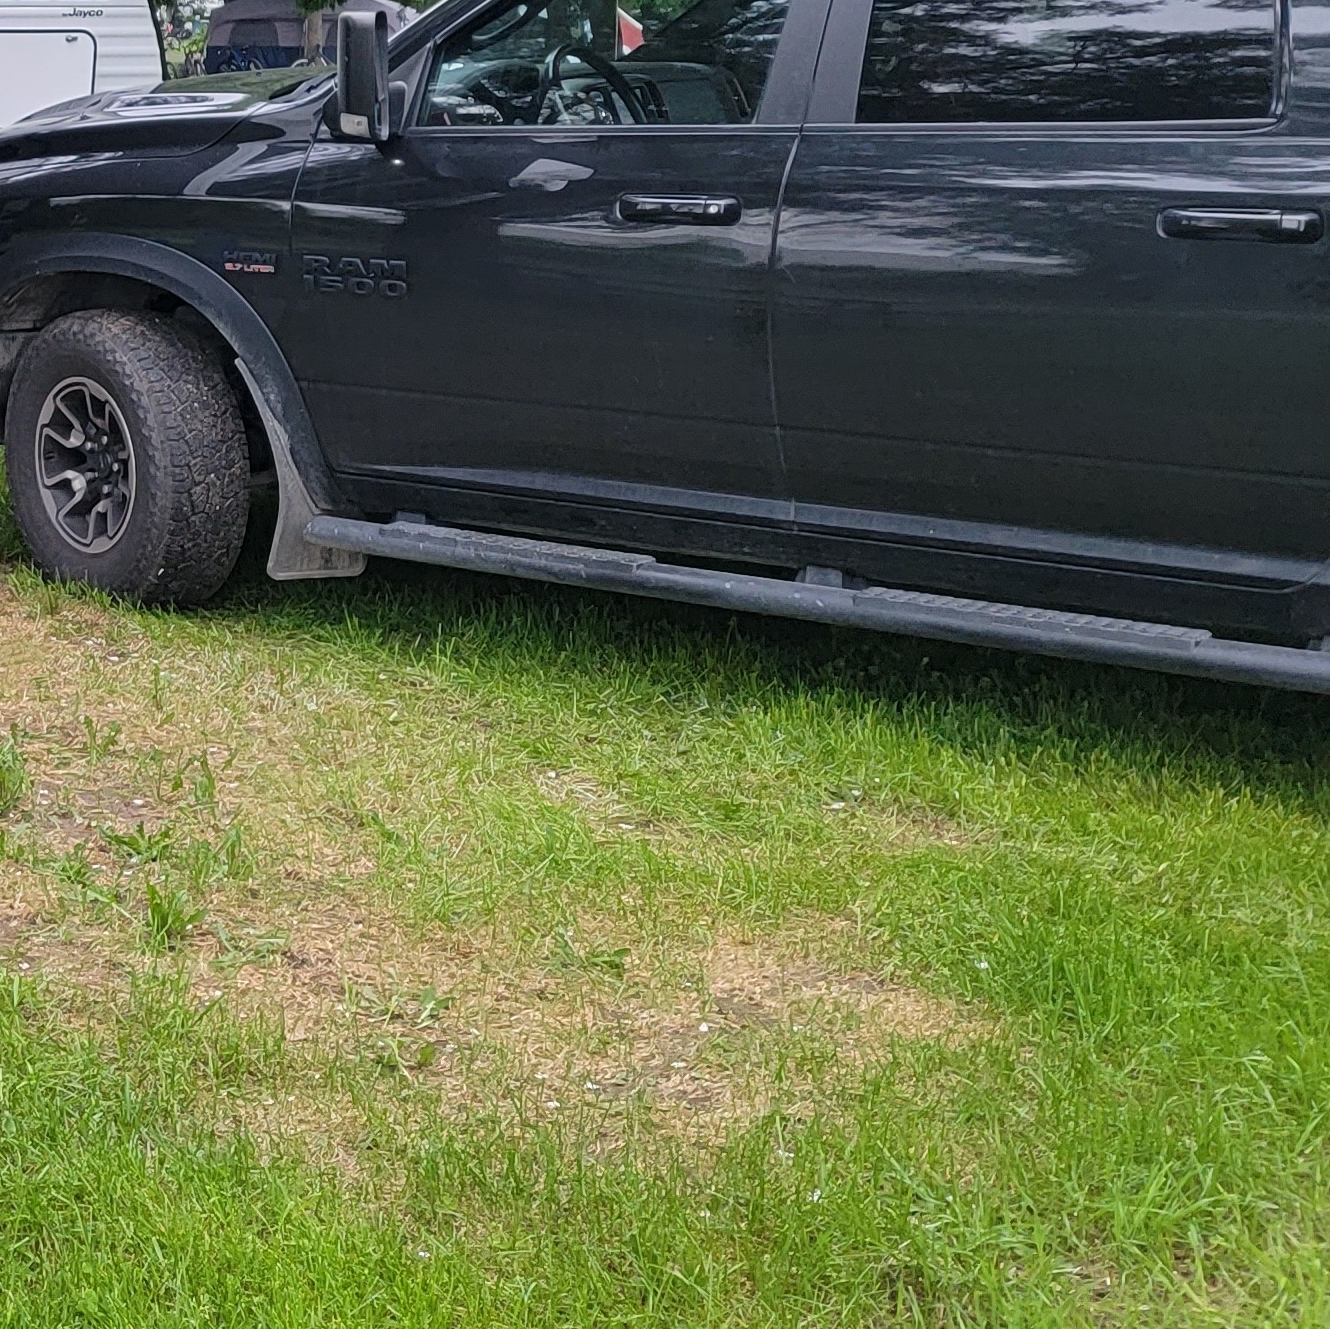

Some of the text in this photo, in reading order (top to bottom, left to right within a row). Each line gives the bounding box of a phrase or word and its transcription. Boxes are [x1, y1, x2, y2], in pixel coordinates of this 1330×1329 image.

[68, 7, 104, 19] Jayco
[302, 254, 407, 278] RAM
[302, 274, 407, 296] 1500
